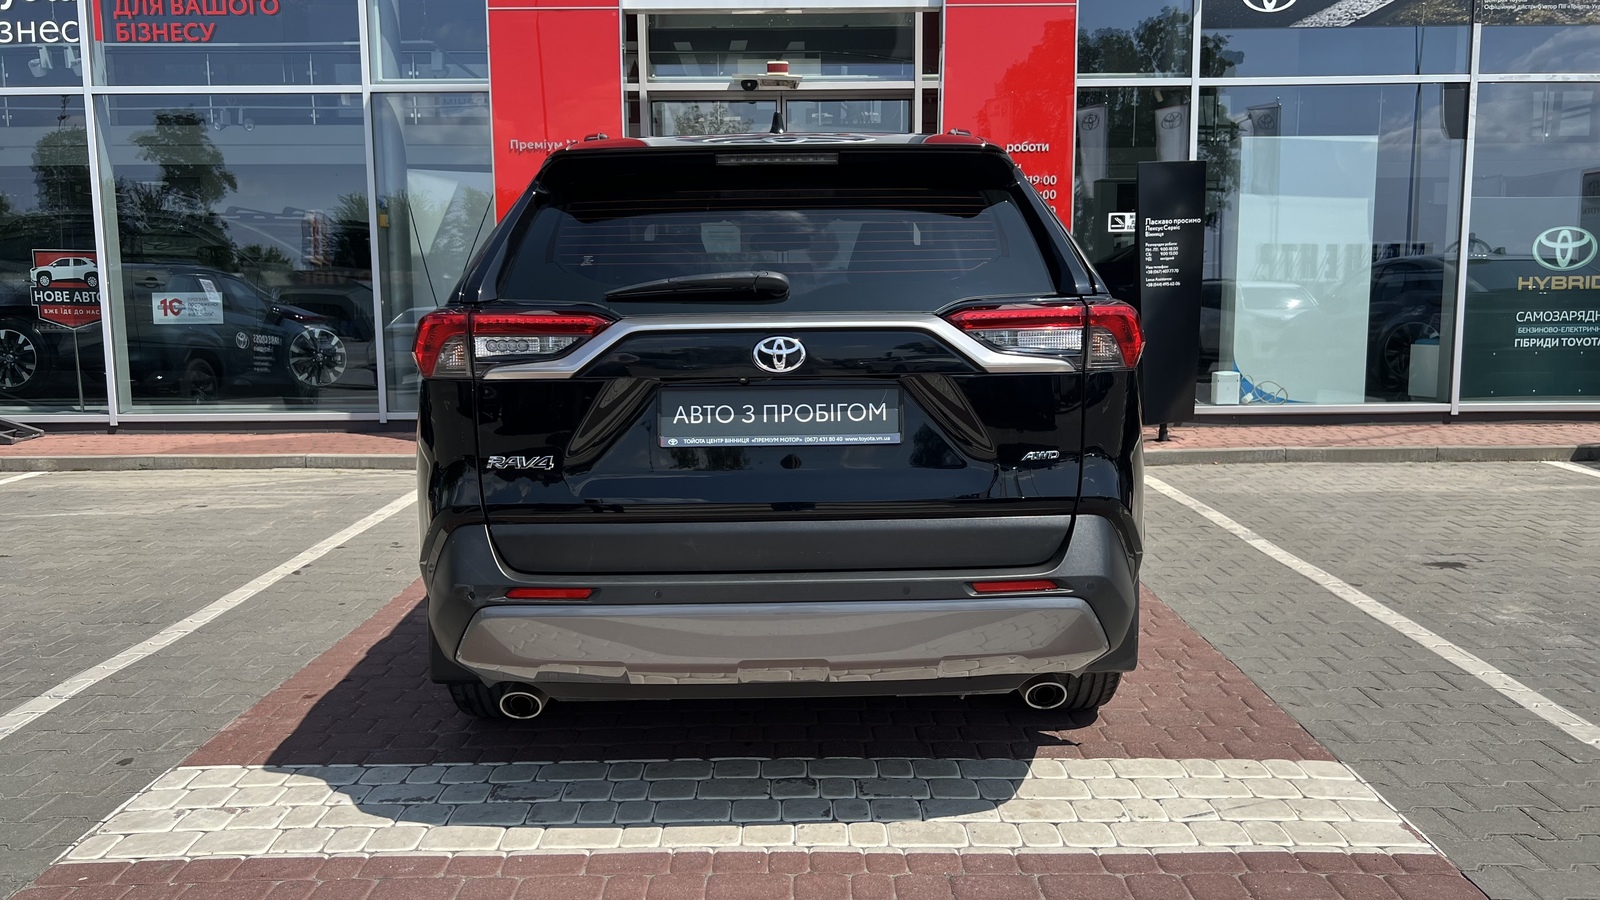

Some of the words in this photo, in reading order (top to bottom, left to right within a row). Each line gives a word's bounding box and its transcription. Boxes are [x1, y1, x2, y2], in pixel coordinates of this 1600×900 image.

[113, 0, 163, 20] ДЛЯ
[170, 0, 280, 16] ВАШОГО
[115, 22, 215, 42] БІЗНЕСУ
[510, 139, 563, 152] Преміум
[1006, 141, 1050, 153] роботи
[1145, 217, 1173, 225] Ласкаво
[34, 290, 70, 302] НОВЕ
[1514, 337, 1559, 348] ГІБРИДИ
[672, 405, 735, 425] АВТО
[763, 402, 887, 423] ПРОБІГОМ
[683, 437, 706, 445] ТОЙОТА
[706, 437, 724, 445] ЦЕНТР
[845, 435, 891, 443] www.toyota.vn.ua
[1021, 450, 1060, 461] AWD
[486, 455, 554, 470] RAV4
